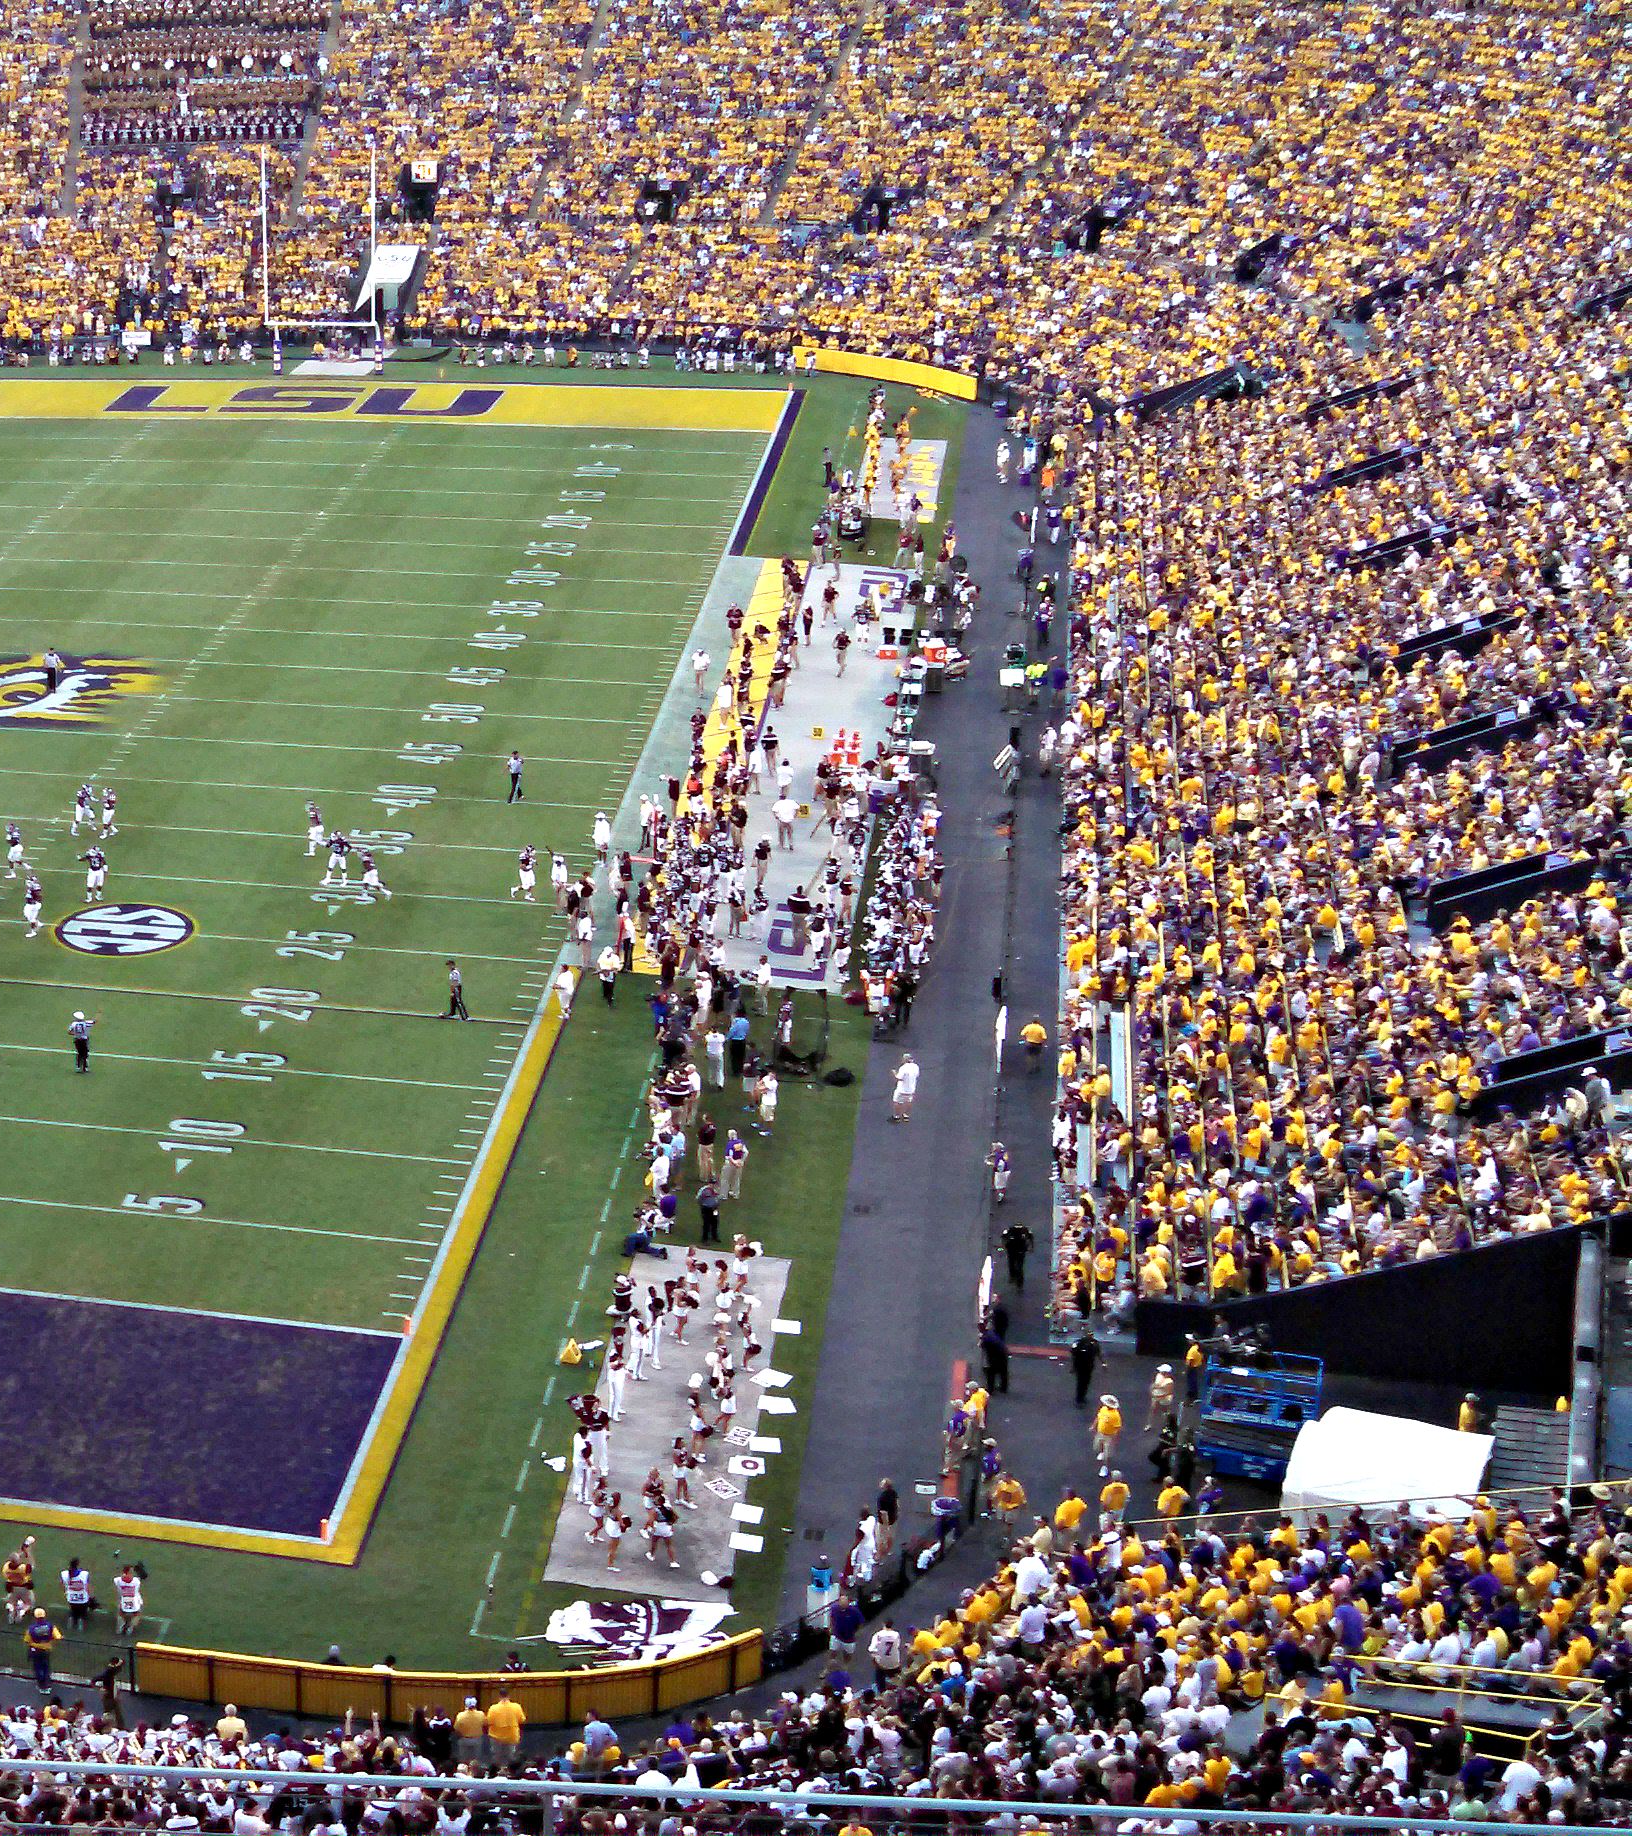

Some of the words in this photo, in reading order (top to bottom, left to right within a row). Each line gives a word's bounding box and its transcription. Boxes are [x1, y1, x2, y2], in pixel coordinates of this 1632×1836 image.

[103, 386, 505, 416] LSU
[540, 515, 593, 529] 20
[523, 541, 579, 556] 25
[505, 569, 562, 586] 30
[487, 600, 545, 617] 35
[466, 632, 528, 651] 40
[446, 666, 508, 686] 45
[421, 703, 486, 724] 50
[396, 742, 464, 765] 45
[371, 784, 438, 808] 40
[59, 905, 188, 954] SEC
[275, 930, 356, 961] 25
[239, 986, 321, 1022] 20
[201, 1049, 288, 1083] 15
[157, 1118, 248, 1154] 10
[121, 1192, 206, 1215] 5
[884, 1641, 894, 1656] 7
